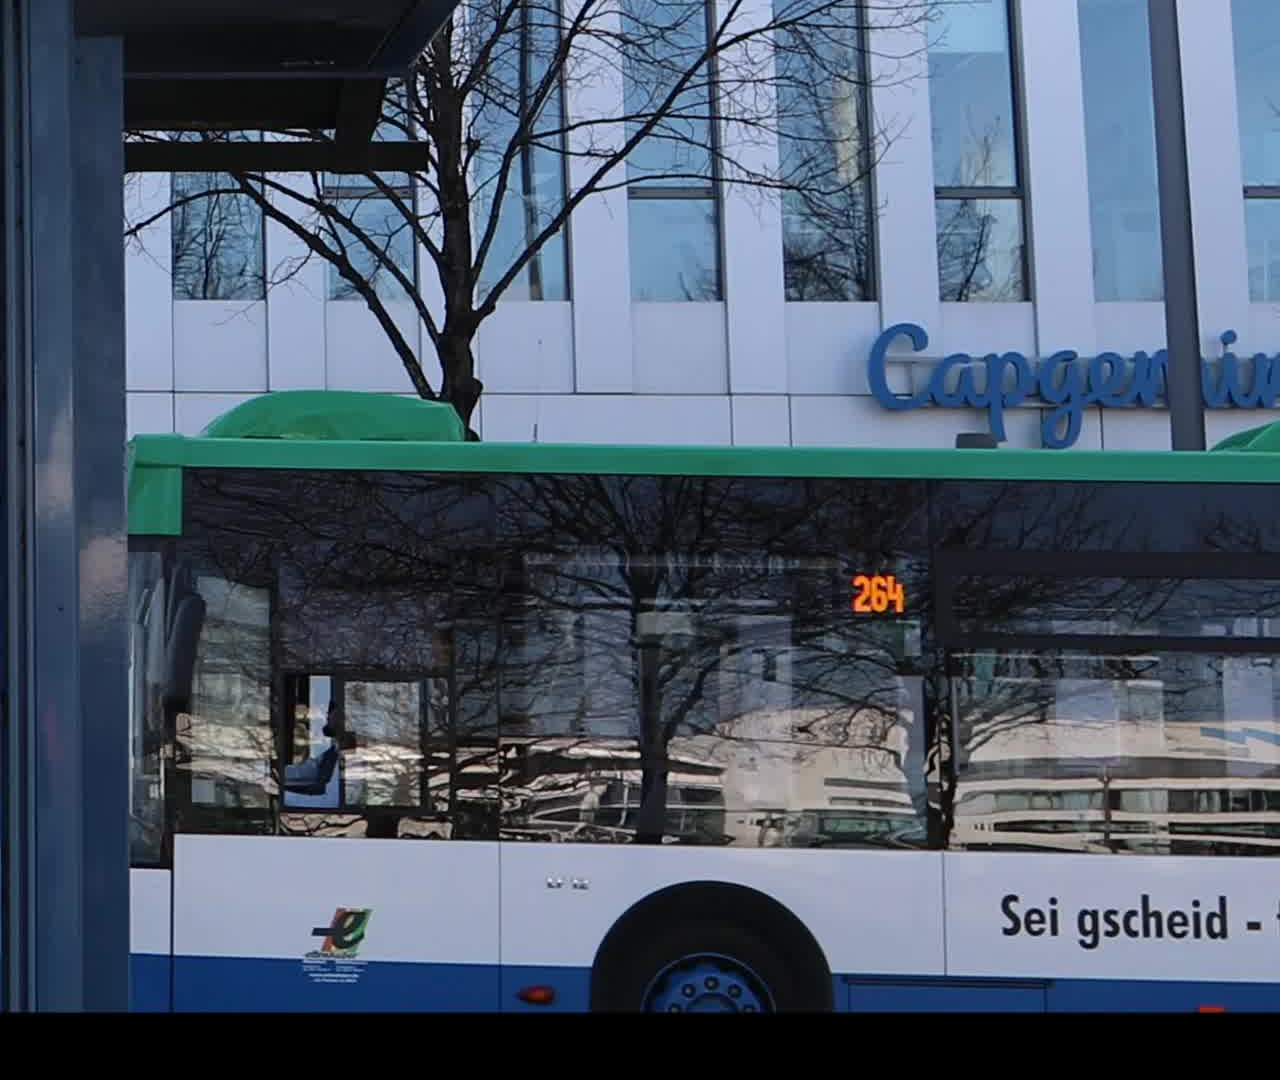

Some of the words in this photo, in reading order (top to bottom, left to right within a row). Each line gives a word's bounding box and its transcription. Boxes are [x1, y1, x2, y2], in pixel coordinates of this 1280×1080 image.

[852, 575, 904, 612] 264
[1001, 894, 1059, 937] Sei
[1077, 894, 1228, 949] gscheid
